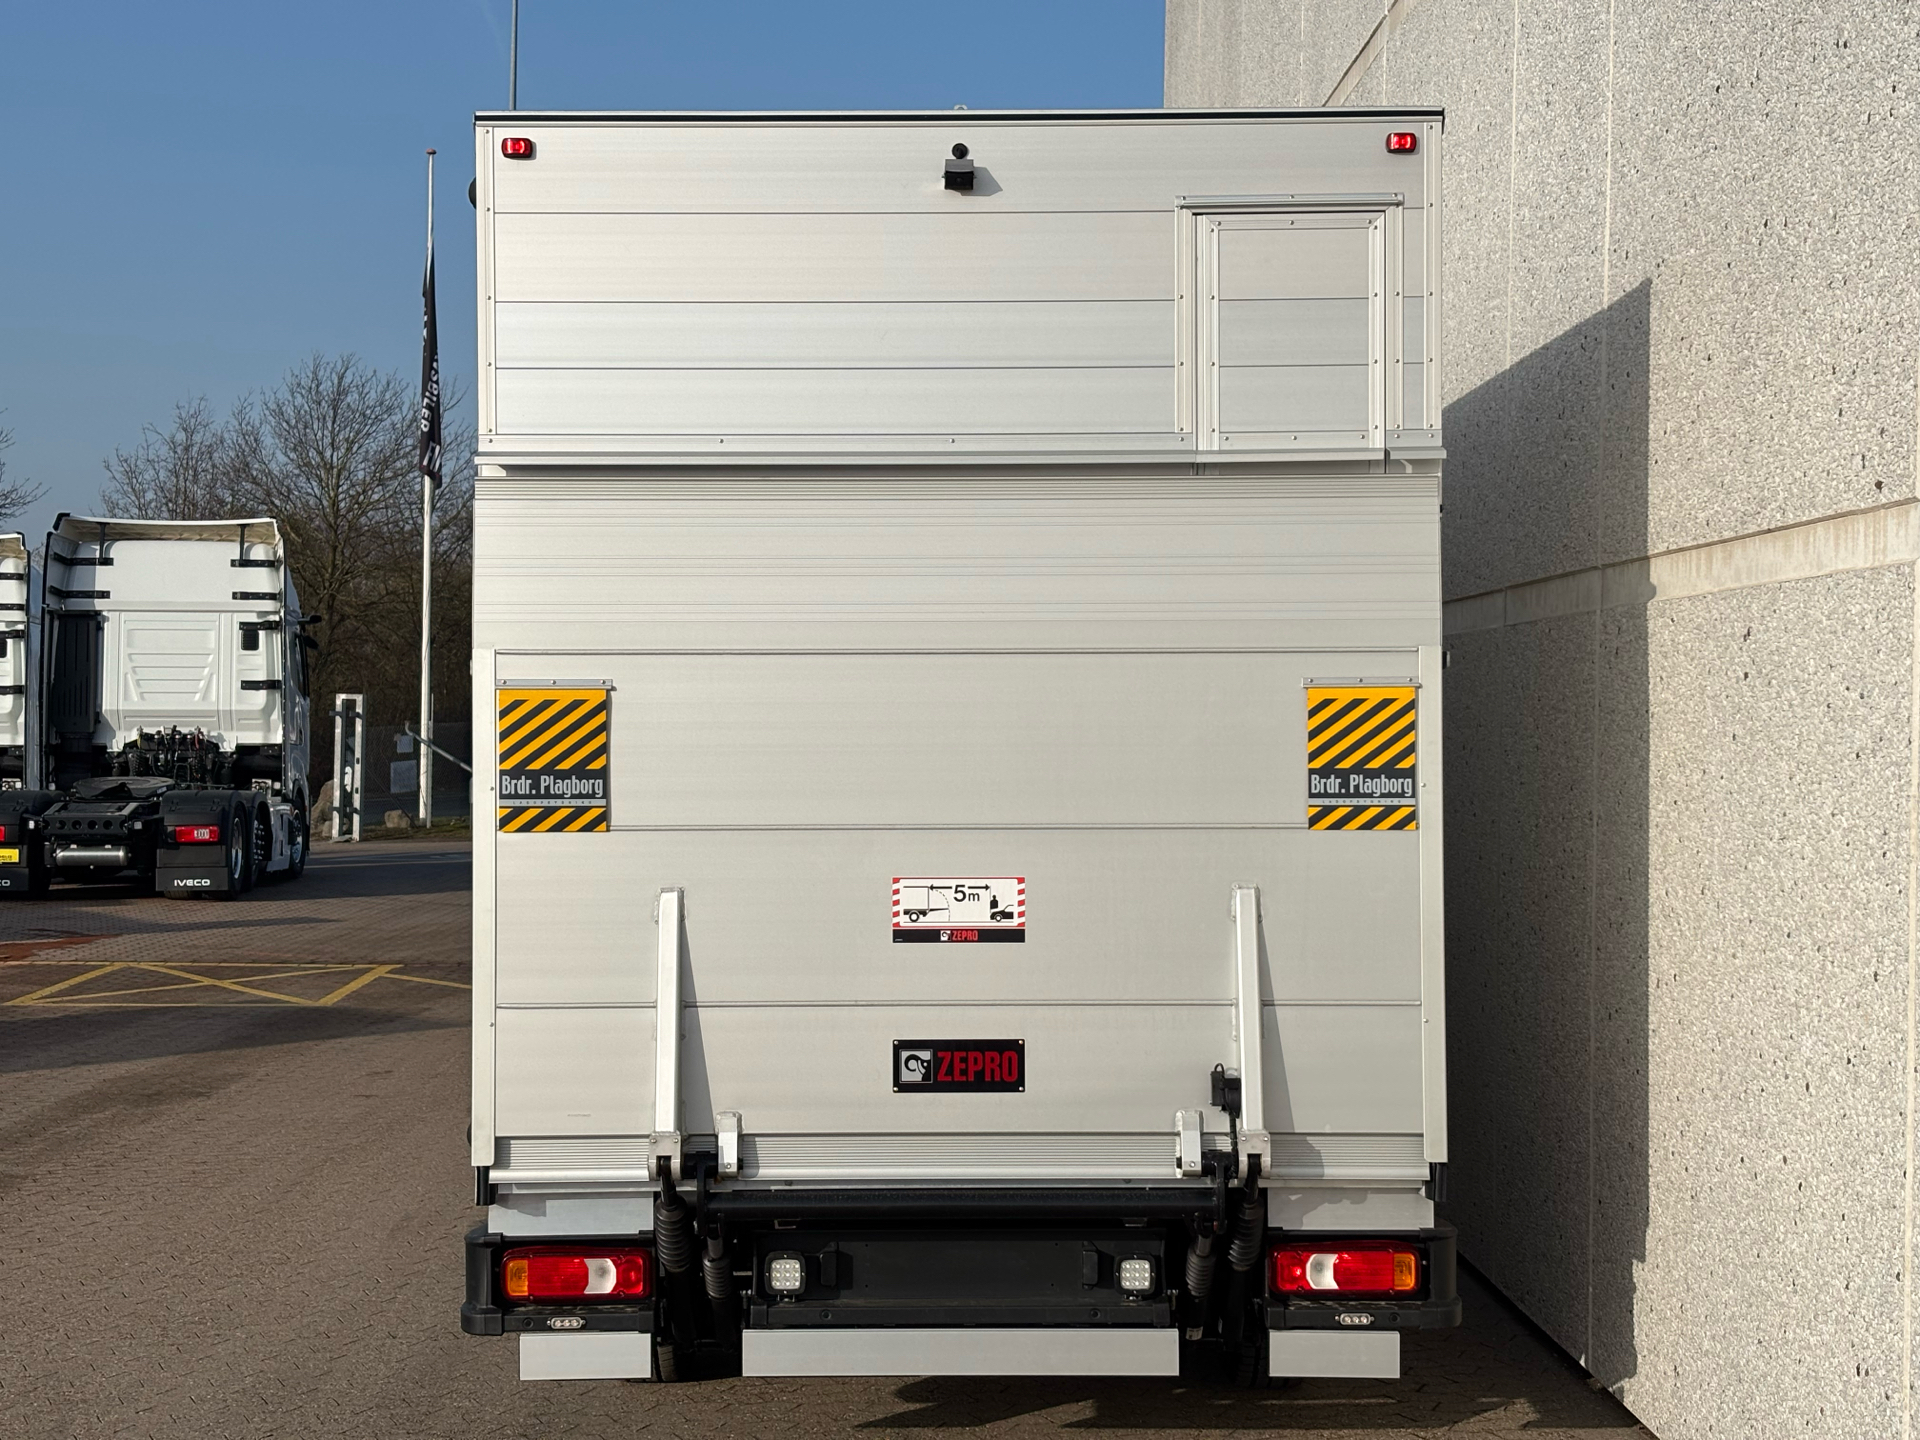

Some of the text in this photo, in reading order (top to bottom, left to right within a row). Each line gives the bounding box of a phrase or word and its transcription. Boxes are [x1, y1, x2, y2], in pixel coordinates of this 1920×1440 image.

[501, 775, 604, 798] Brdr. Plagborg
[1310, 774, 1412, 797] Brdr. Plagborg
[952, 930, 978, 941] ZEPRO
[937, 1051, 1018, 1082] ZEPRO
